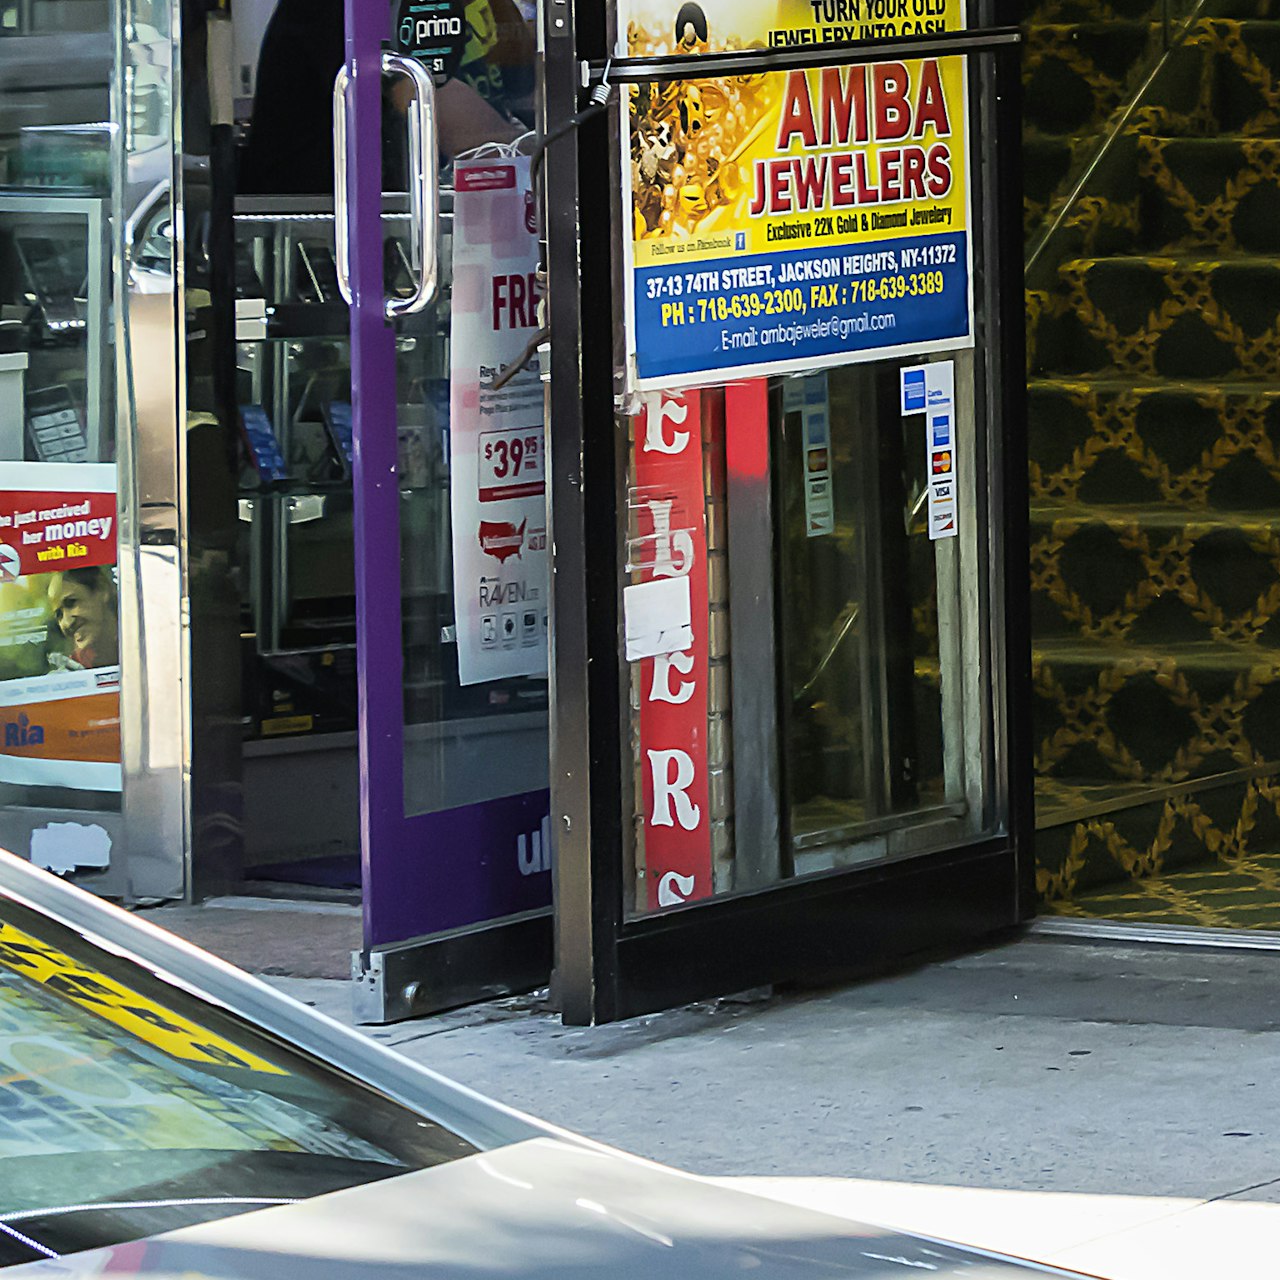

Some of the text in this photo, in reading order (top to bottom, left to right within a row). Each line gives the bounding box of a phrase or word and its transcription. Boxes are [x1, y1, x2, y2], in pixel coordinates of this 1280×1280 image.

[416, 14, 462, 45] primo
[777, 58, 951, 150] AMBA
[749, 144, 954, 218] JEWELERS
[766, 219, 812, 242] Exclusive
[814, 217, 833, 237] 22K
[836, 214, 859, 234] Gold
[861, 215, 869, 232] &
[871, 209, 908, 231] Diamond
[646, 244, 956, 300] 37-13 74TH STREET, JACKSON HEIGHTS, NY-11372
[661, 303, 685, 328] PH
[697, 287, 807, 323] 718-639-2300,
[810, 283, 839, 306] FAX
[850, 272, 944, 303] 718-639-3389
[721, 311, 897, 352] E-mail: ambajeweler@gmail.com
[935, 485, 951, 497] VISA
[38, 500, 90, 521] received
[45, 517, 113, 540] money
[67, 542, 88, 558] Ria
[5, 713, 45, 747] Ria
